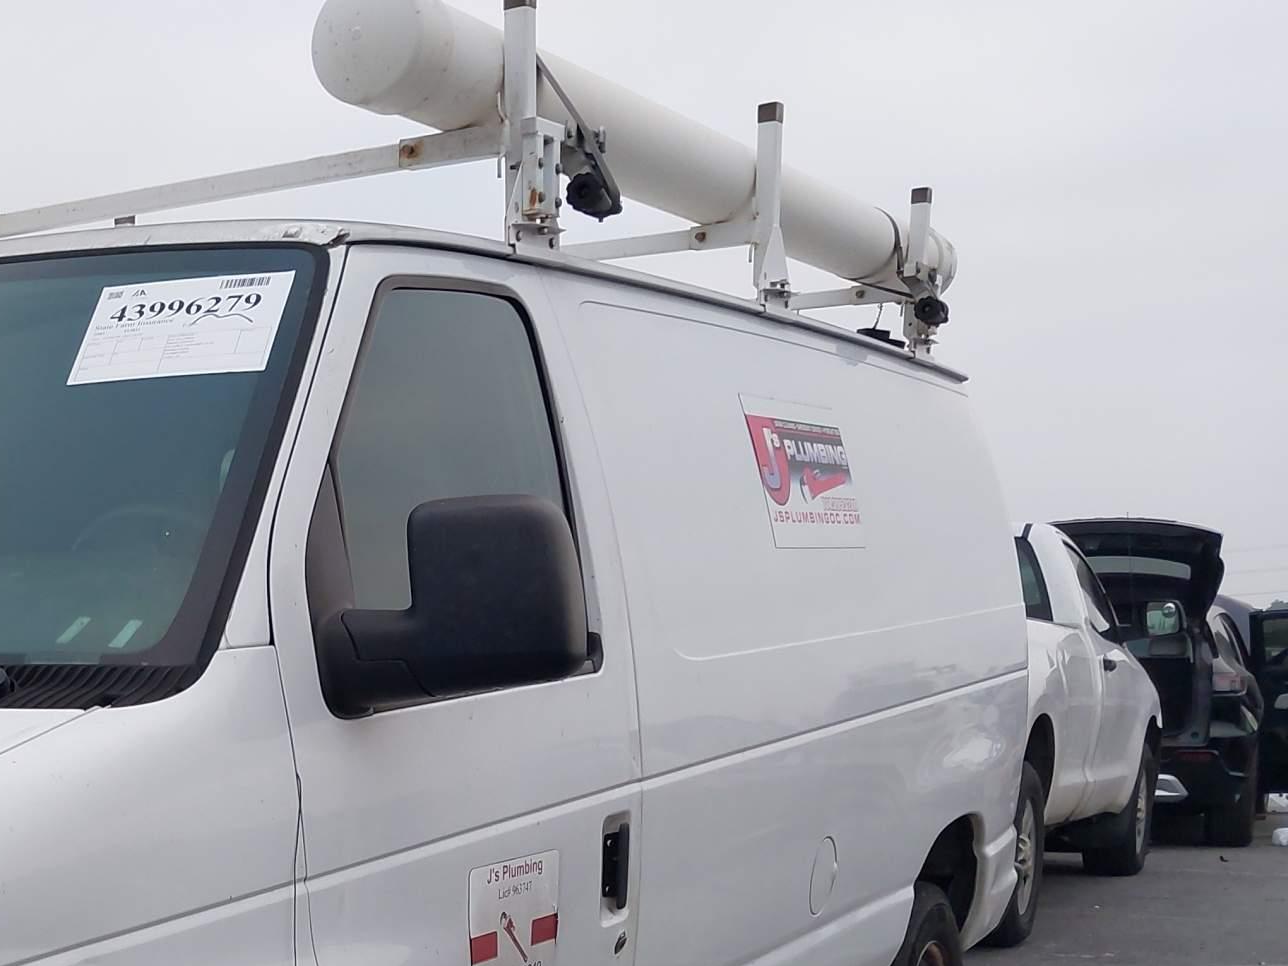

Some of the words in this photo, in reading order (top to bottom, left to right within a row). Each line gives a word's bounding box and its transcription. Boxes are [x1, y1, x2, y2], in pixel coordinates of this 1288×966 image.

[110, 293, 262, 322] 43996279
[782, 438, 848, 466] PLUMBING
[487, 868, 500, 884] J's
[502, 859, 543, 881] Plumbing
